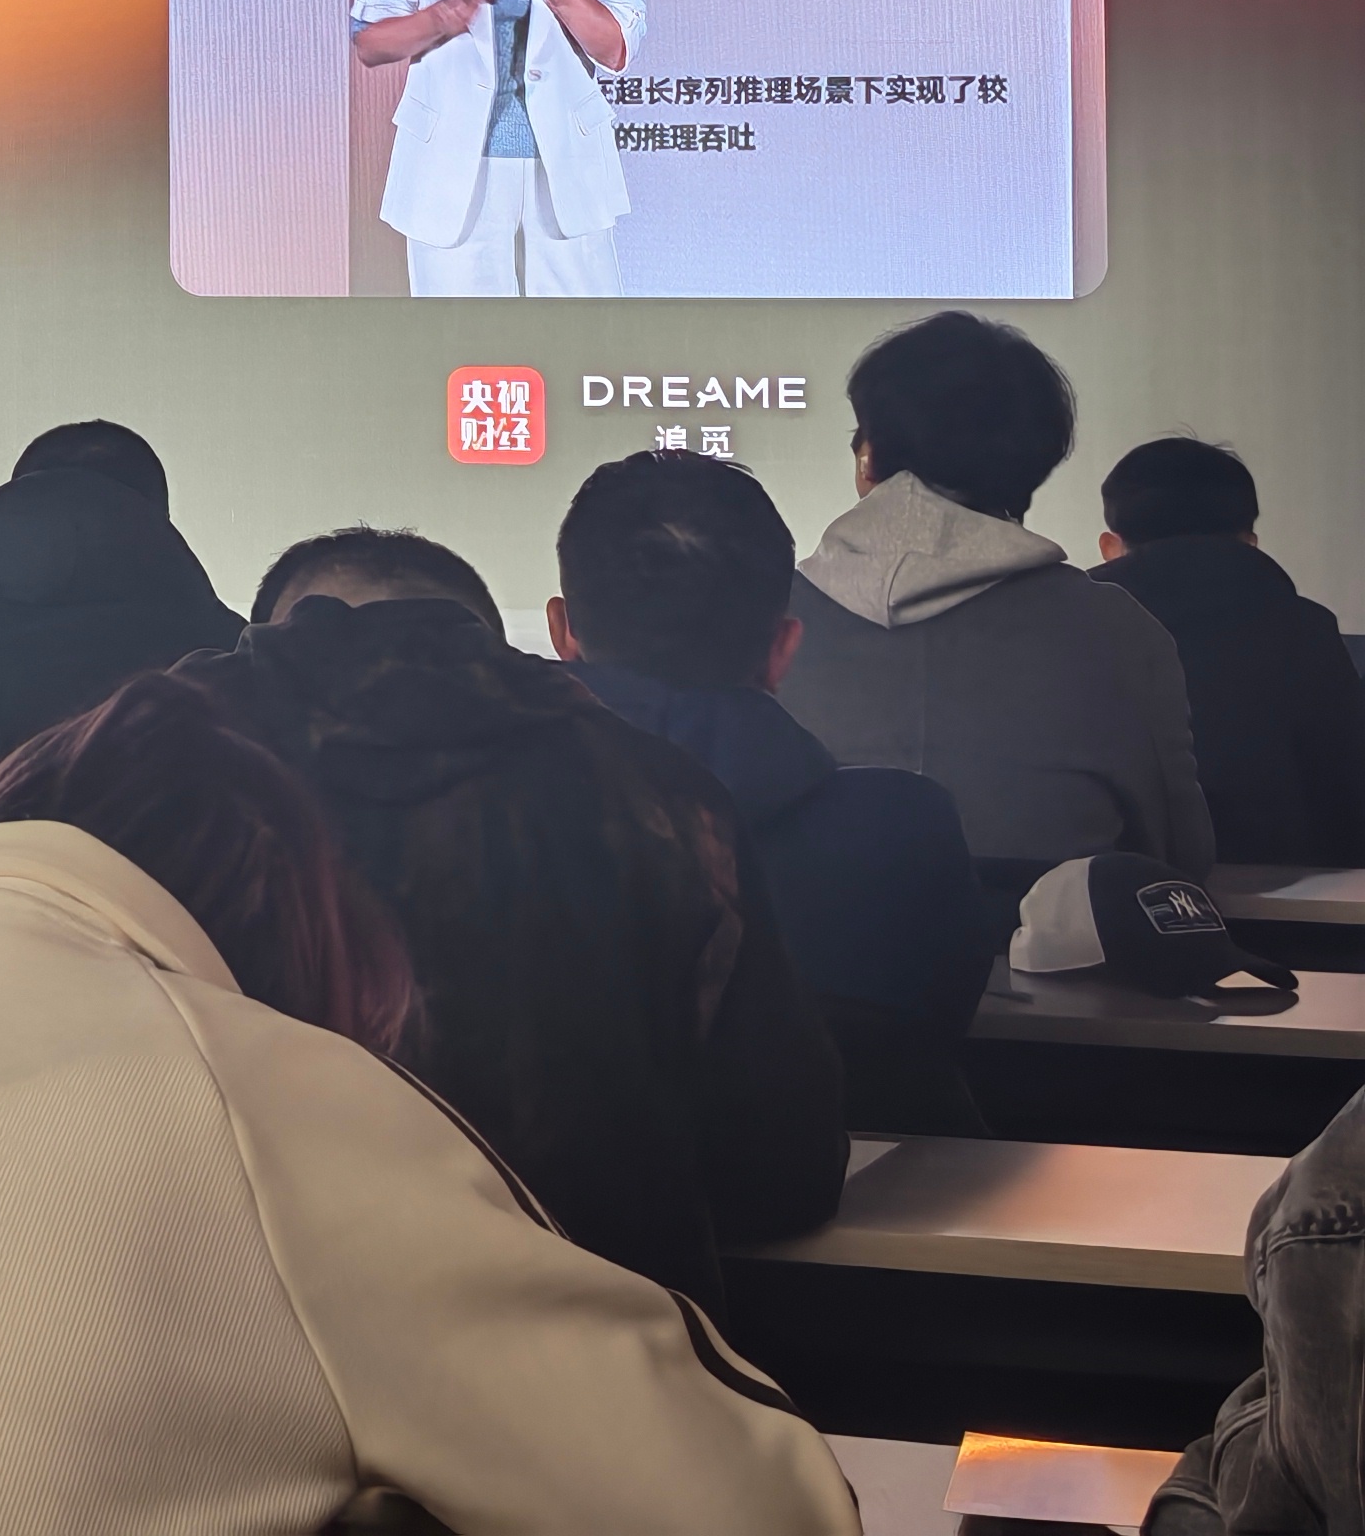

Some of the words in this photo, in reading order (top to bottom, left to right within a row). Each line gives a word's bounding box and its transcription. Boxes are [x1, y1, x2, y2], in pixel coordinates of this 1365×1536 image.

[460, 379, 530, 415] 央视
[582, 375, 807, 409] DREAME
[460, 416, 531, 452] 财经
